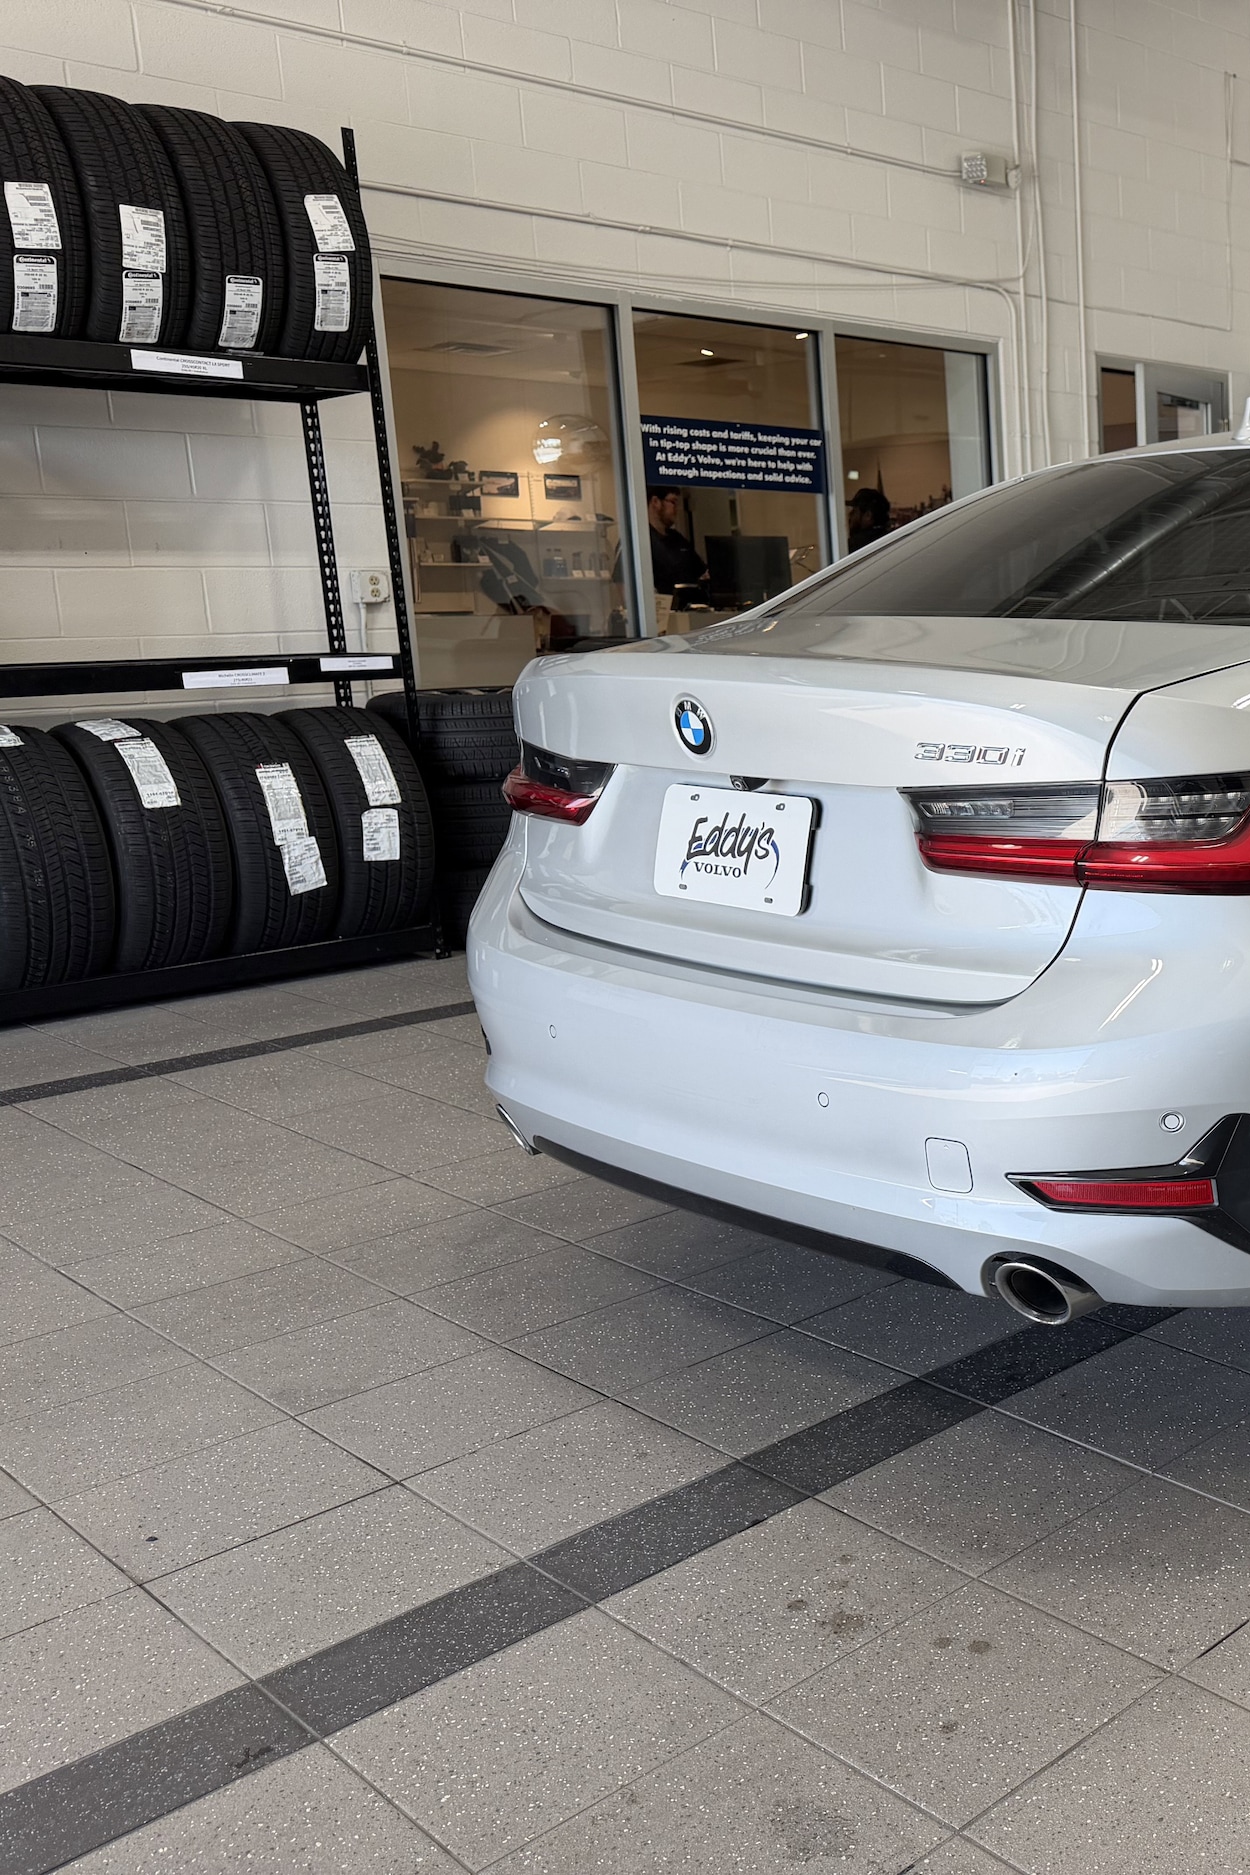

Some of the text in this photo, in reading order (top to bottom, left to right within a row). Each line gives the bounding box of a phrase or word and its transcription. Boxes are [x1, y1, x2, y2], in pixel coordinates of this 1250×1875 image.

[640, 423, 822, 447] With rising costs and tariffs, keeping your car
[649, 437, 816, 459] in tip-top shape is more crucial than ever.
[655, 452, 813, 472] At Eddy's Volvo, we're here to help with
[658, 465, 812, 484] thorough inspections and solid advice.
[914, 742, 1026, 767] 330i
[686, 811, 775, 876] Eddy's
[693, 861, 742, 879] VOLVO
